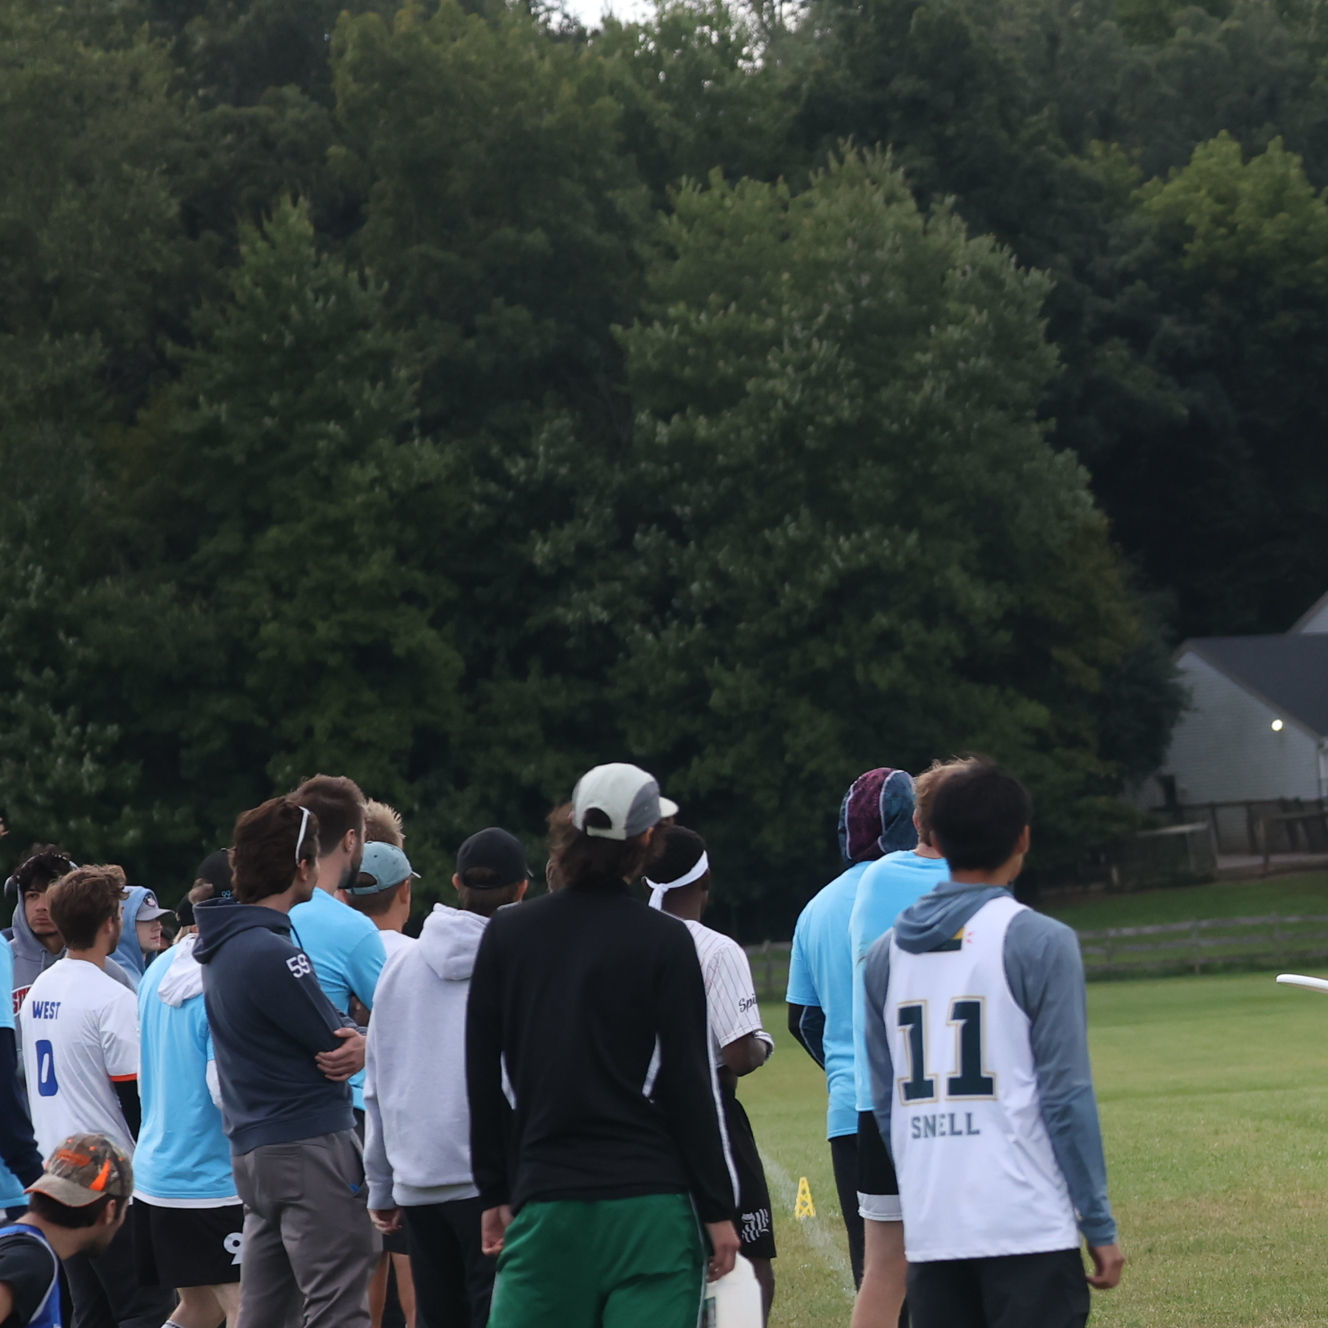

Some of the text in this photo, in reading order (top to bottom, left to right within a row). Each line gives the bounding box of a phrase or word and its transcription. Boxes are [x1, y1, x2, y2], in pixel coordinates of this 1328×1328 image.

[285, 953, 312, 979] 59
[32, 1000, 61, 1020] WEST
[896, 995, 998, 1107] 11
[35, 1039, 59, 1097] 0
[911, 1111, 981, 1139] SNELL
